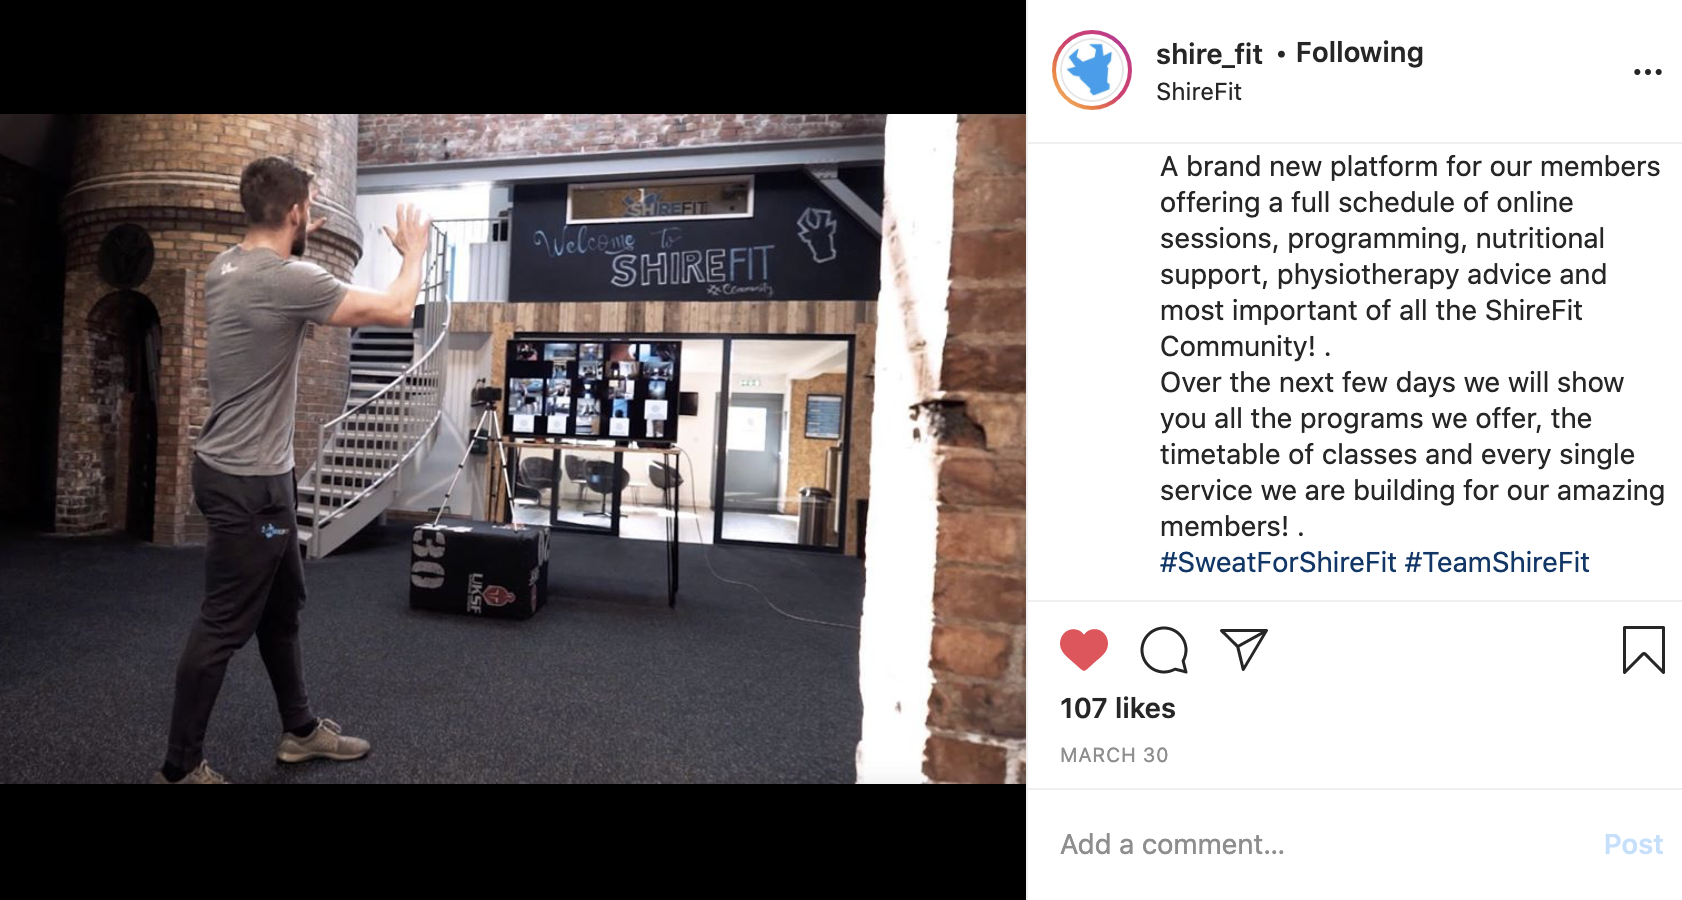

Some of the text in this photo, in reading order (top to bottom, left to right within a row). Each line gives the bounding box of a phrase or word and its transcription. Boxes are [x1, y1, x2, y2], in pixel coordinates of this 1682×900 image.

[628, 200, 708, 217] SHIREFIT
[533, 225, 635, 256] Welcome
[611, 245, 775, 287] SHIREFIT
[411, 529, 446, 589] 30
[470, 573, 484, 614] UKSF
